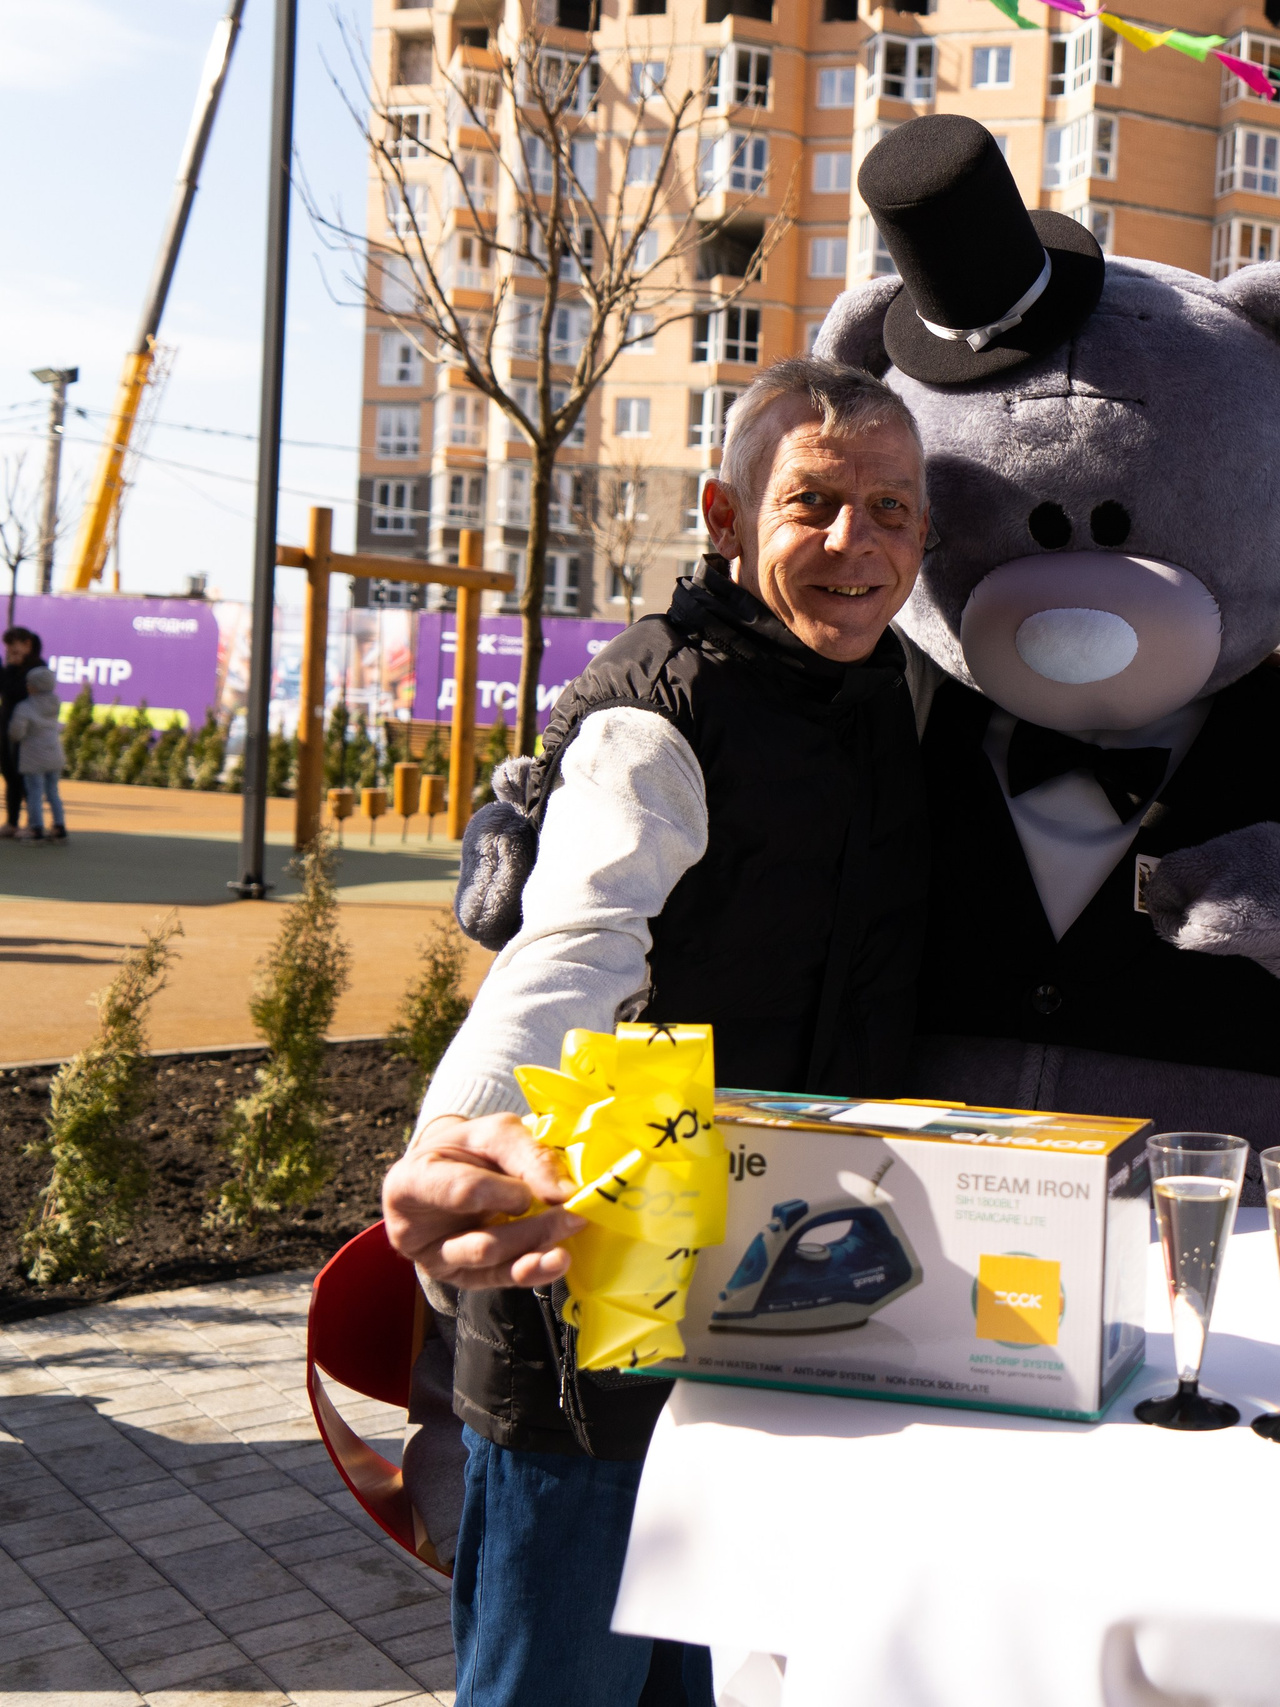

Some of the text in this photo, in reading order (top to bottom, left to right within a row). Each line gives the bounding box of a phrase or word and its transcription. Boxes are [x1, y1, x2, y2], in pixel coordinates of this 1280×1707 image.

[49, 655, 132, 686] ЕНТР
[437, 678, 570, 712] ДТСИ
[951, 1132, 1107, 1150] gorenje
[957, 1172, 1030, 1195] STEAM
[1037, 1178, 1090, 1199] IRON
[839, 1370, 876, 1382] SYSTEM
[886, 1375, 935, 1388] NON-STICK
[937, 1380, 990, 1393] SOLEPLATE
